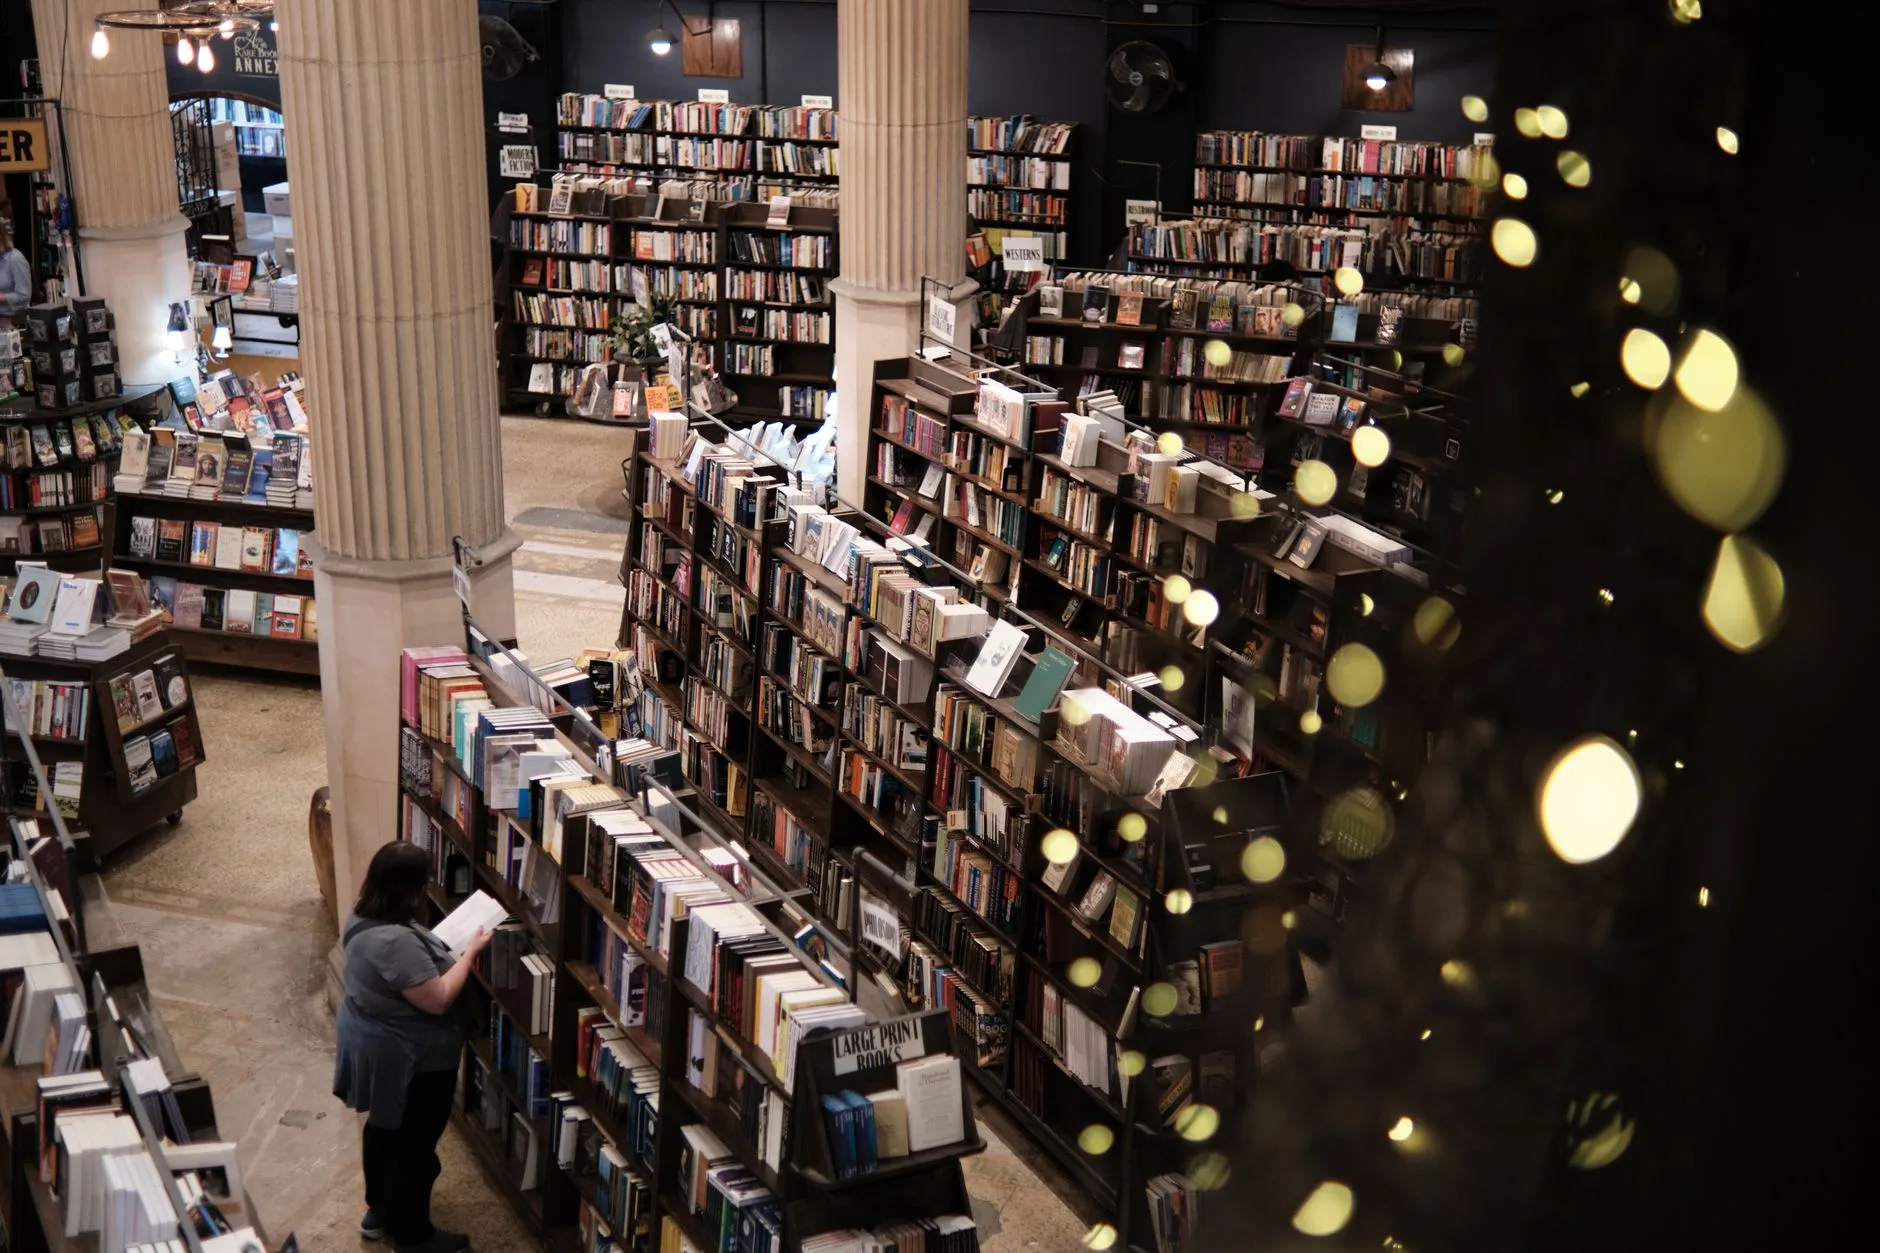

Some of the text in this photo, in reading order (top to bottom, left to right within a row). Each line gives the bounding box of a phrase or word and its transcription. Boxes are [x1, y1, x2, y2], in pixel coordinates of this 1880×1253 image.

[0, 129, 34, 163] ER
[1004, 248, 1041, 261] WESTERNS
[835, 1017, 919, 1058] LARGE PRINT
[856, 1045, 904, 1071] BOOKS
